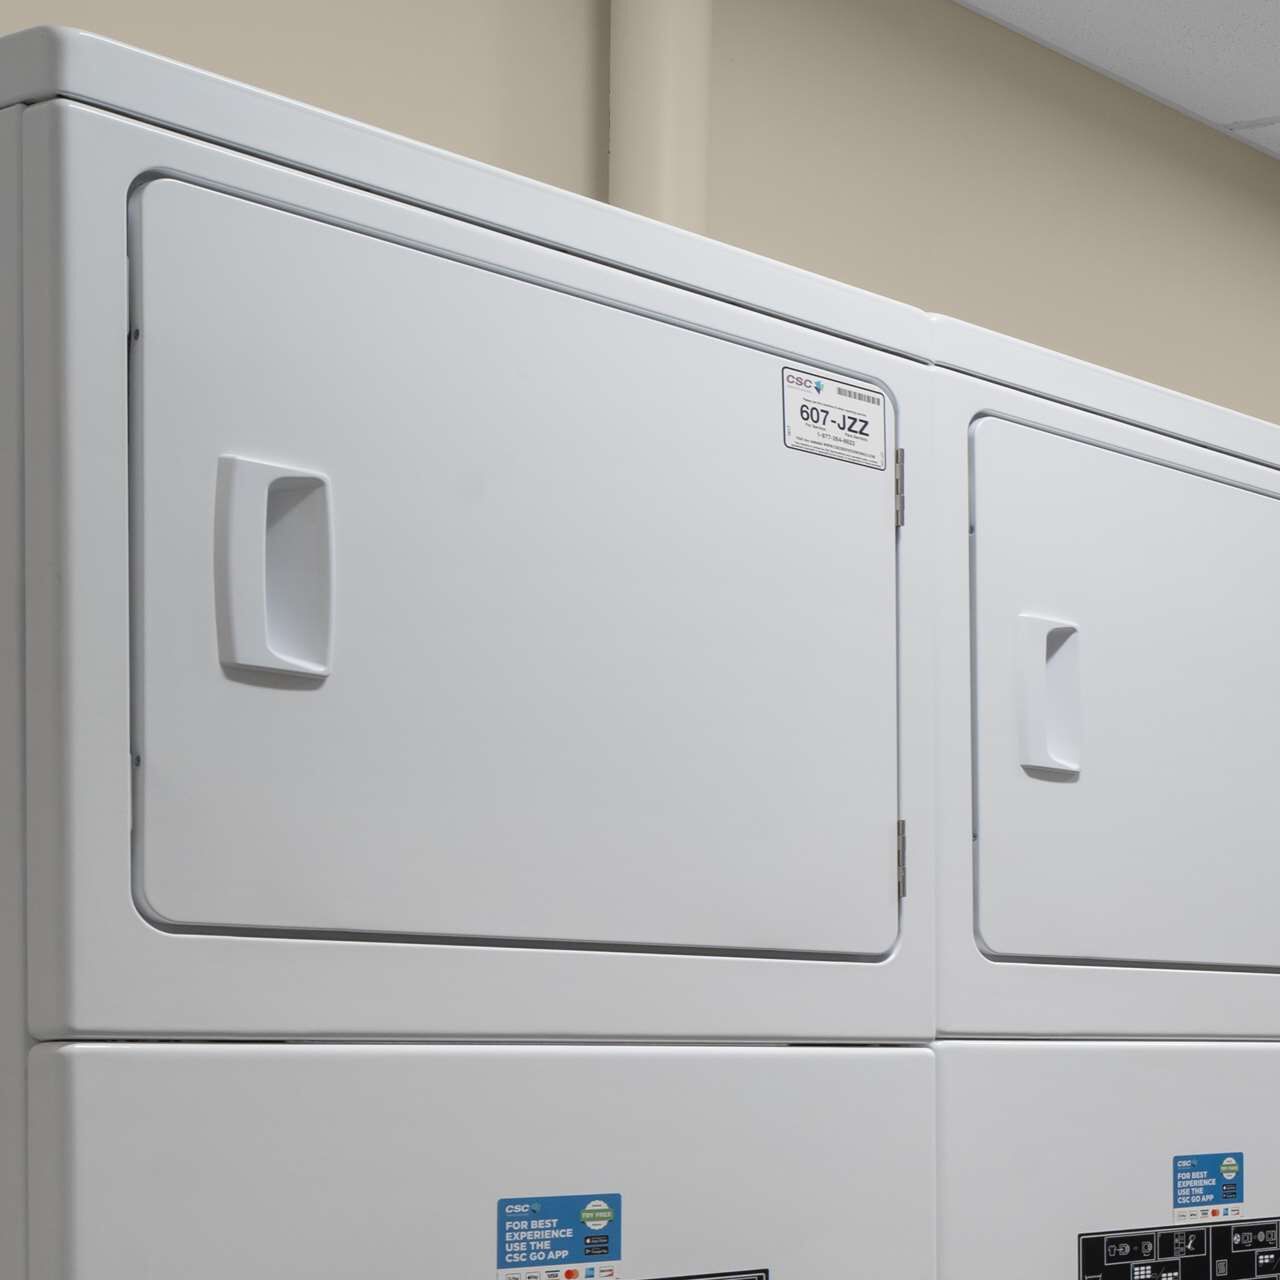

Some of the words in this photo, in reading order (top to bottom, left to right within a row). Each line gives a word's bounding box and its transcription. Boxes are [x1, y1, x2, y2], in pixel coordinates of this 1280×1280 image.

[786, 374, 813, 389] CSC
[800, 404, 870, 437] 607-JZZ
[1192, 1171, 1208, 1179] BEST
[1178, 1179, 1216, 1188] EXPERIENCE
[505, 1204, 529, 1213] CSC
[505, 1221, 528, 1231] FOR
[531, 1219, 558, 1229] BEST
[505, 1229, 573, 1241] EXPERIENCE
[505, 1242, 527, 1252] USE
[529, 1241, 551, 1250] THE
[505, 1253, 527, 1263] CSC
[529, 1252, 546, 1261] GO
[547, 1250, 569, 1260] APP
